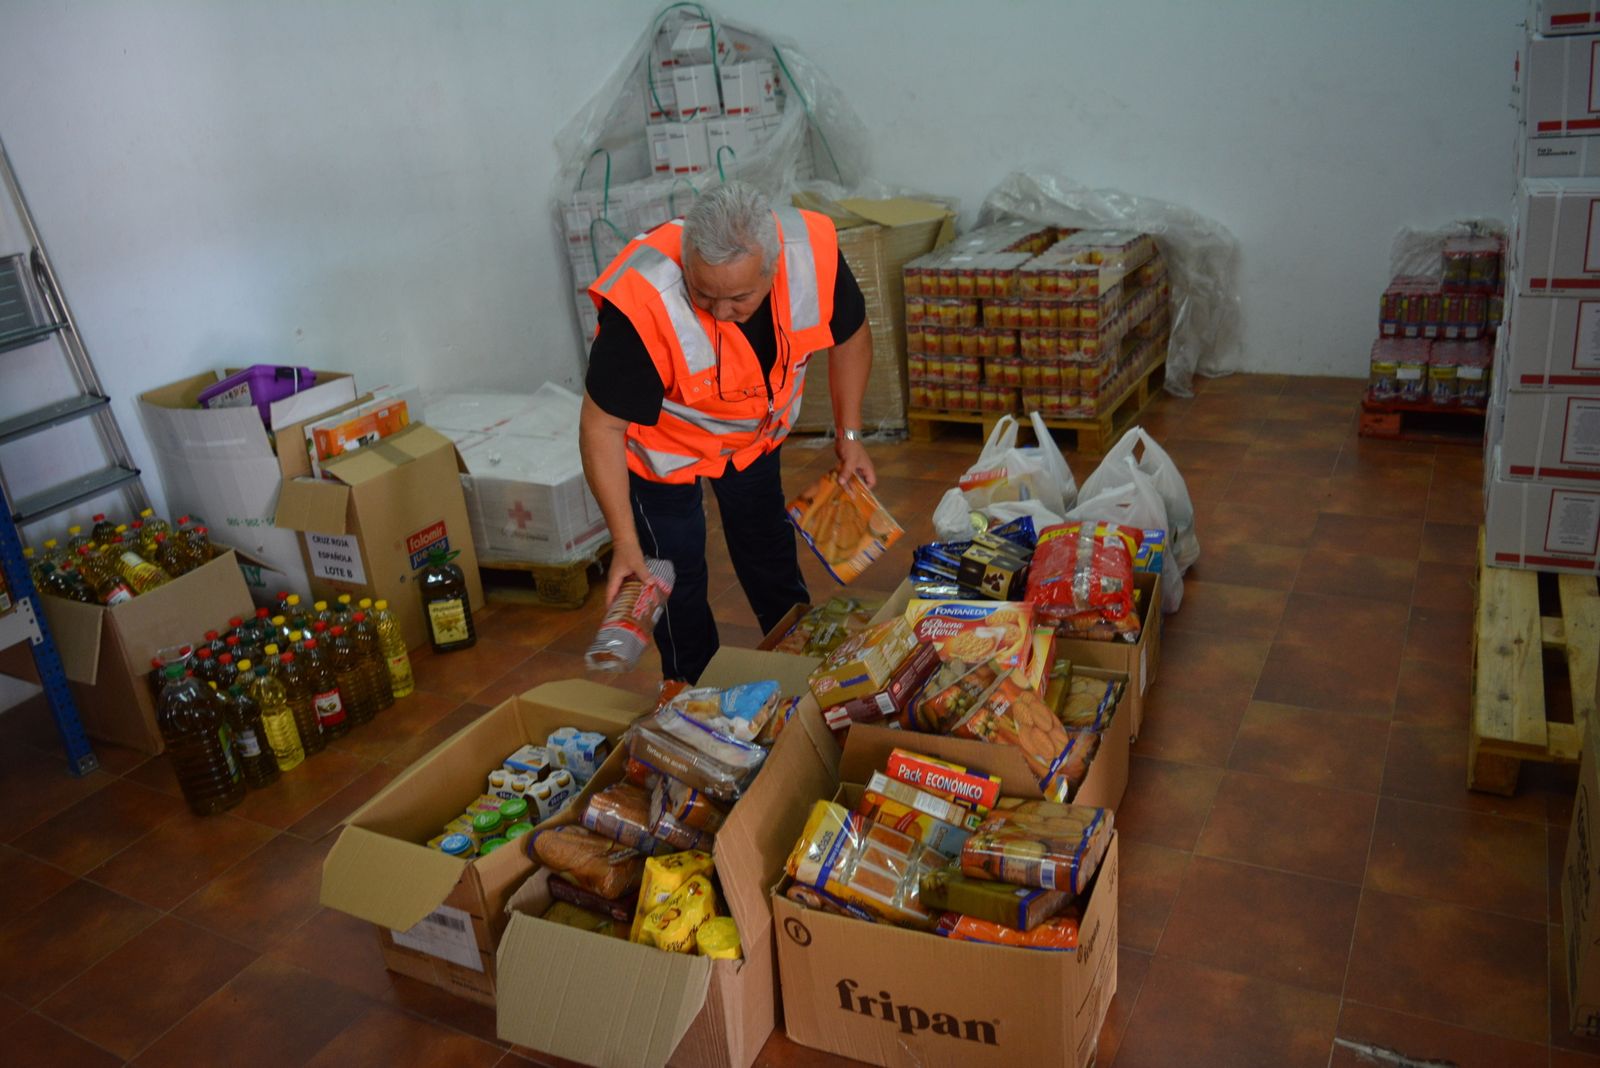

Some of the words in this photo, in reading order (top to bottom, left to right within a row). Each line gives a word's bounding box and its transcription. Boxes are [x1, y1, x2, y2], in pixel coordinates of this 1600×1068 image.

[312, 535, 330, 546] CRUZ
[331, 538, 349, 547] ROJA
[409, 528, 445, 551] falomir
[318, 552, 353, 563] ESPAÑOLA
[325, 566, 346, 578] LOTE
[347, 569, 353, 579] B
[934, 607, 988, 617] FONTANEDA
[897, 764, 922, 782] Pack
[924, 772, 984, 801] ECONÓMICO
[835, 978, 999, 1046] fripan
